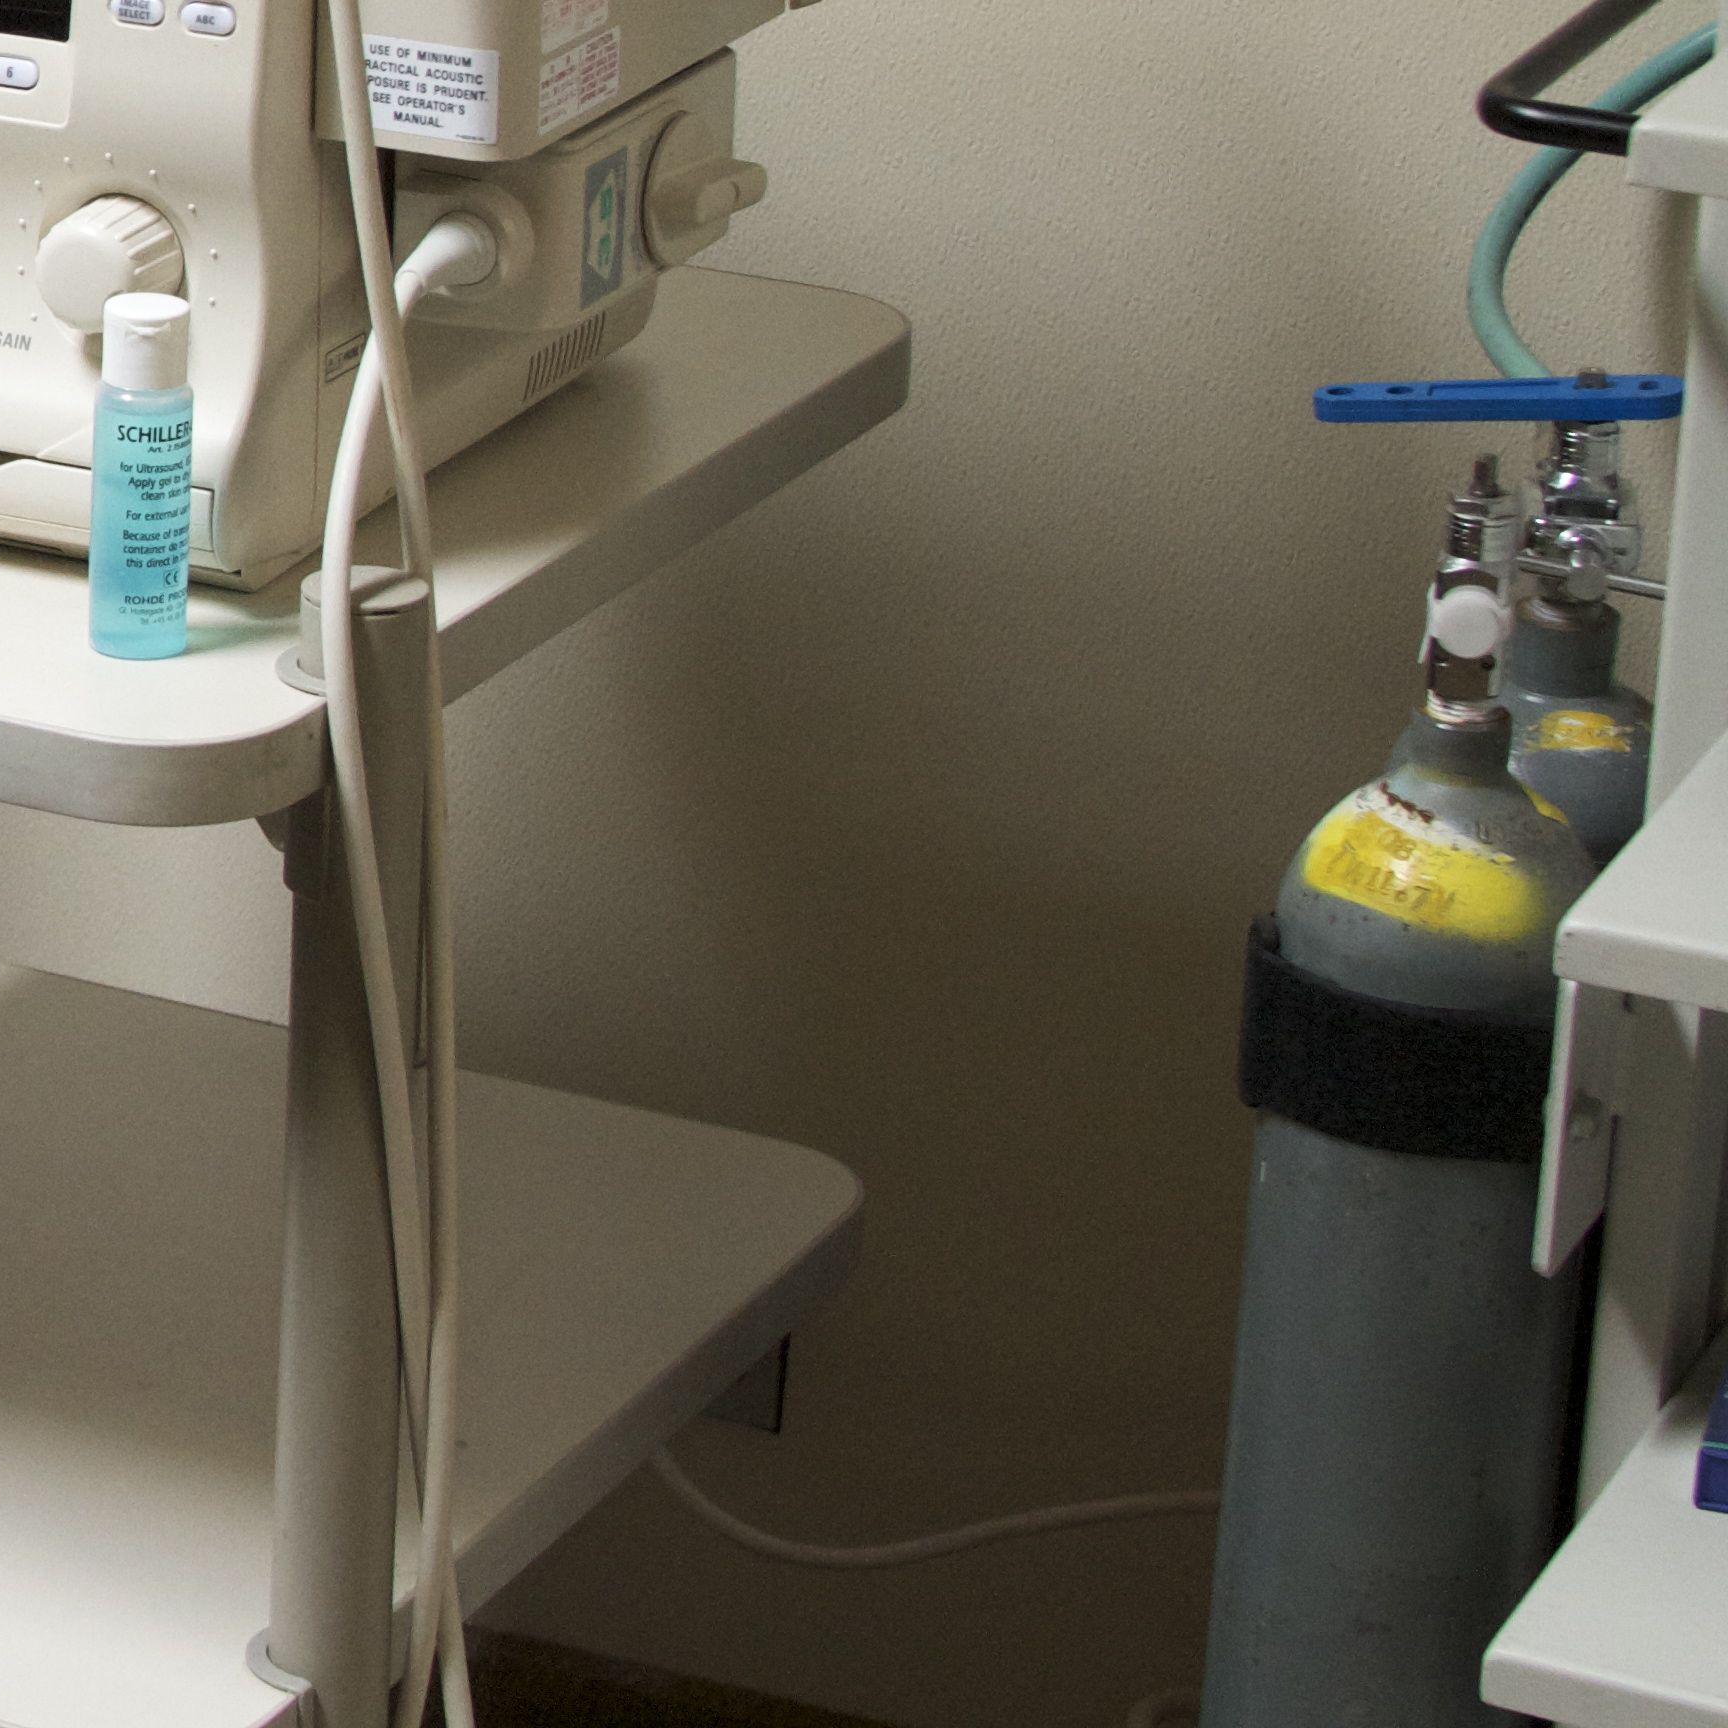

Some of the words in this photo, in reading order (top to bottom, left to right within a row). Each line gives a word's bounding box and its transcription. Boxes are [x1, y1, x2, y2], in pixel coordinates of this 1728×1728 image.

[118, 7, 152, 21] SELECT
[195, 13, 216, 26] ABC
[369, 44, 391, 56] USE
[396, 47, 411, 59] OF
[417, 50, 472, 68] MINIMUM
[5, 66, 14, 79] 6
[365, 58, 419, 77] RACTICAL
[425, 68, 484, 86] ACOUSTIC
[367, 75, 411, 92] POSURE
[416, 83, 427, 94] IS
[433, 85, 489, 103] PRUDENT.
[372, 92, 392, 105] SEE
[397, 96, 466, 116] OPERATOR'S
[120, 461, 134, 472] for
[128, 476, 156, 490] Apply
[158, 476, 173, 490] gel
[140, 491, 165, 502] clean
[125, 509, 141, 522] For
[144, 508, 179, 522] external
[122, 529, 161, 542] Because
[164, 528, 171, 538] of
[123, 544, 166, 556] container
[168, 542, 178, 552] do
[125, 558, 143, 569] this
[146, 557, 171, 569] direct
[172, 554, 180, 565] in
